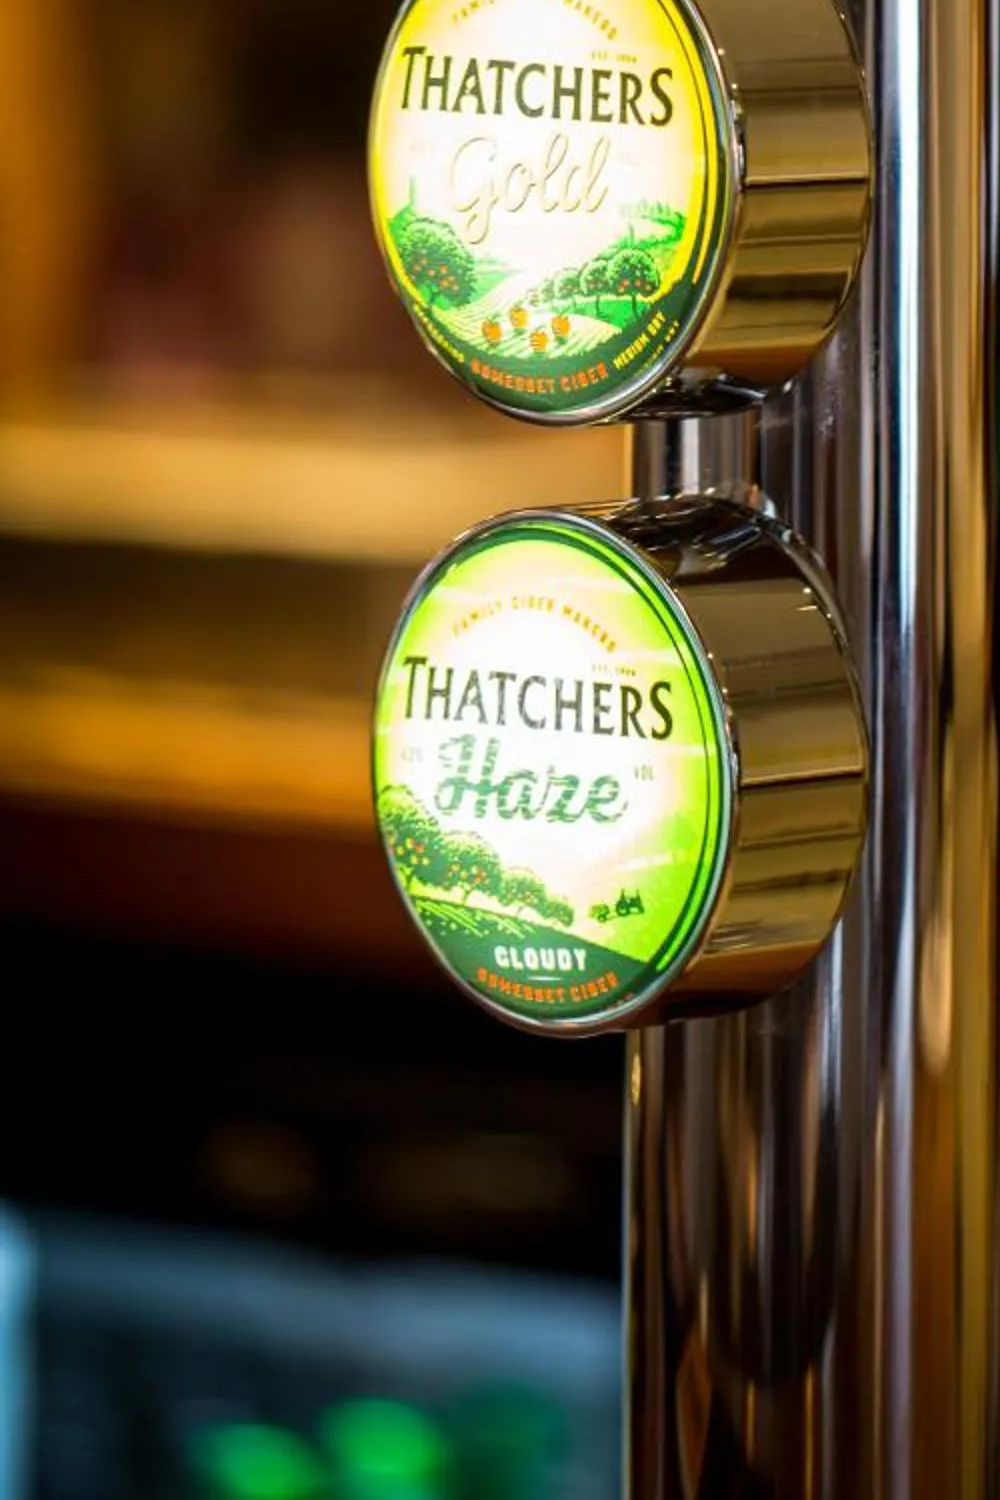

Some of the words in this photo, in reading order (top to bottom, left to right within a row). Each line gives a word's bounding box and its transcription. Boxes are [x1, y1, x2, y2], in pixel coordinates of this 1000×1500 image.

[399, 46, 674, 127] THATCHERS
[449, 130, 611, 246] Gold
[402, 656, 673, 740] THATCHERS
[433, 733, 630, 823] Haze
[493, 945, 587, 972] CLOUDY
